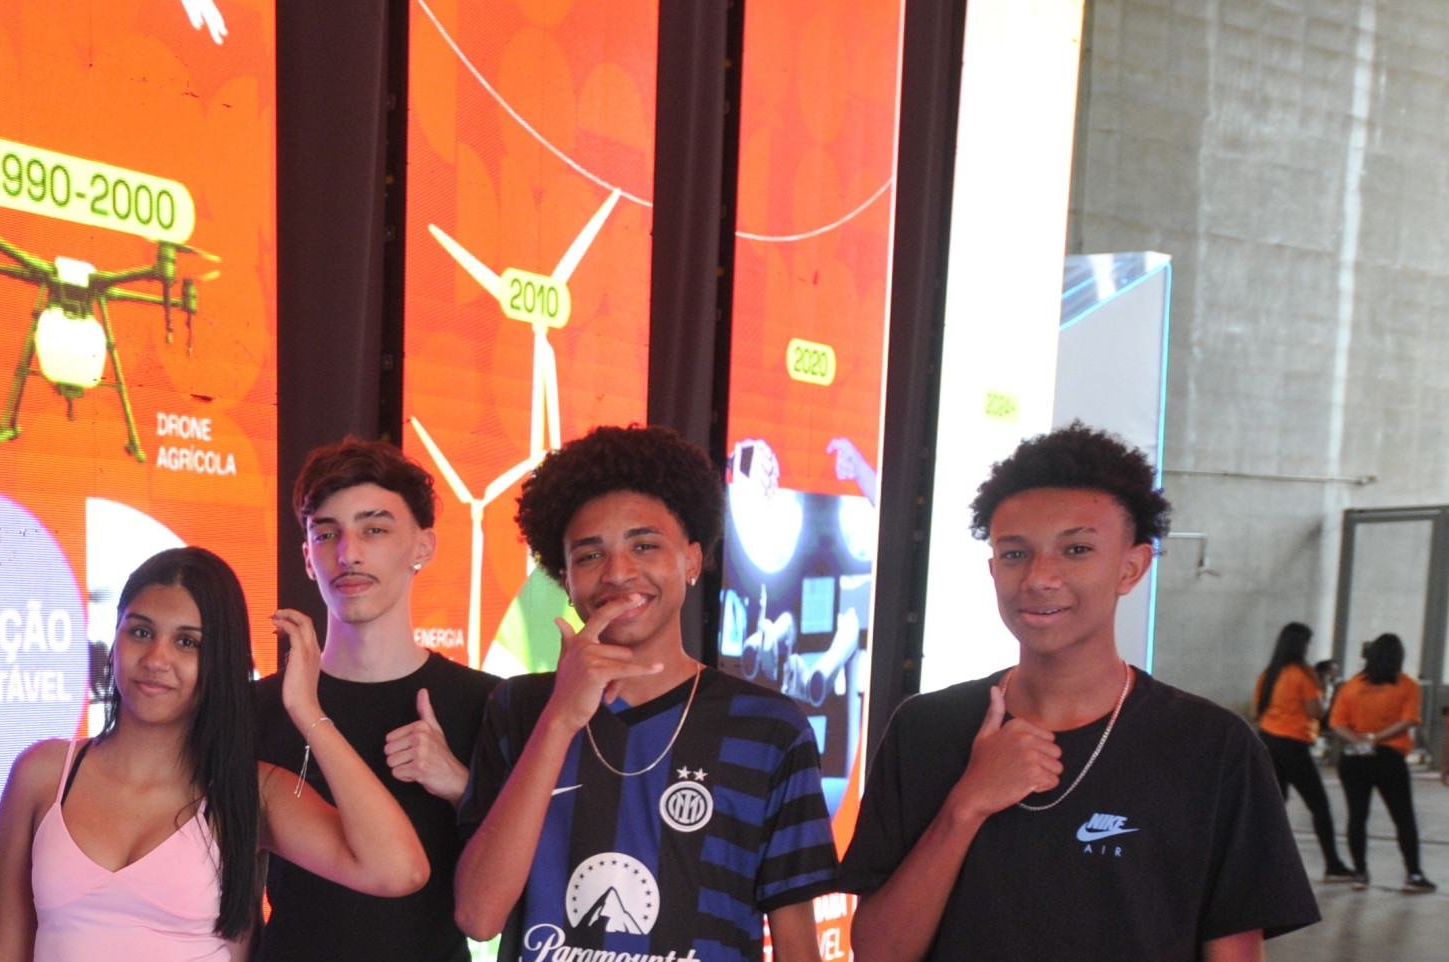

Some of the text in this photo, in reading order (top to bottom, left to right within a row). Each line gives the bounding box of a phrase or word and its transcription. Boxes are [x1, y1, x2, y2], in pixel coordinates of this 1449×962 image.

[509, 277, 559, 318] 2010
[793, 345, 828, 378] 2020
[156, 411, 212, 442] DRONE
[156, 444, 237, 476] AGRÍCOLA
[1086, 812, 1128, 832] NIKE
[1083, 843, 1123, 857] AIR
